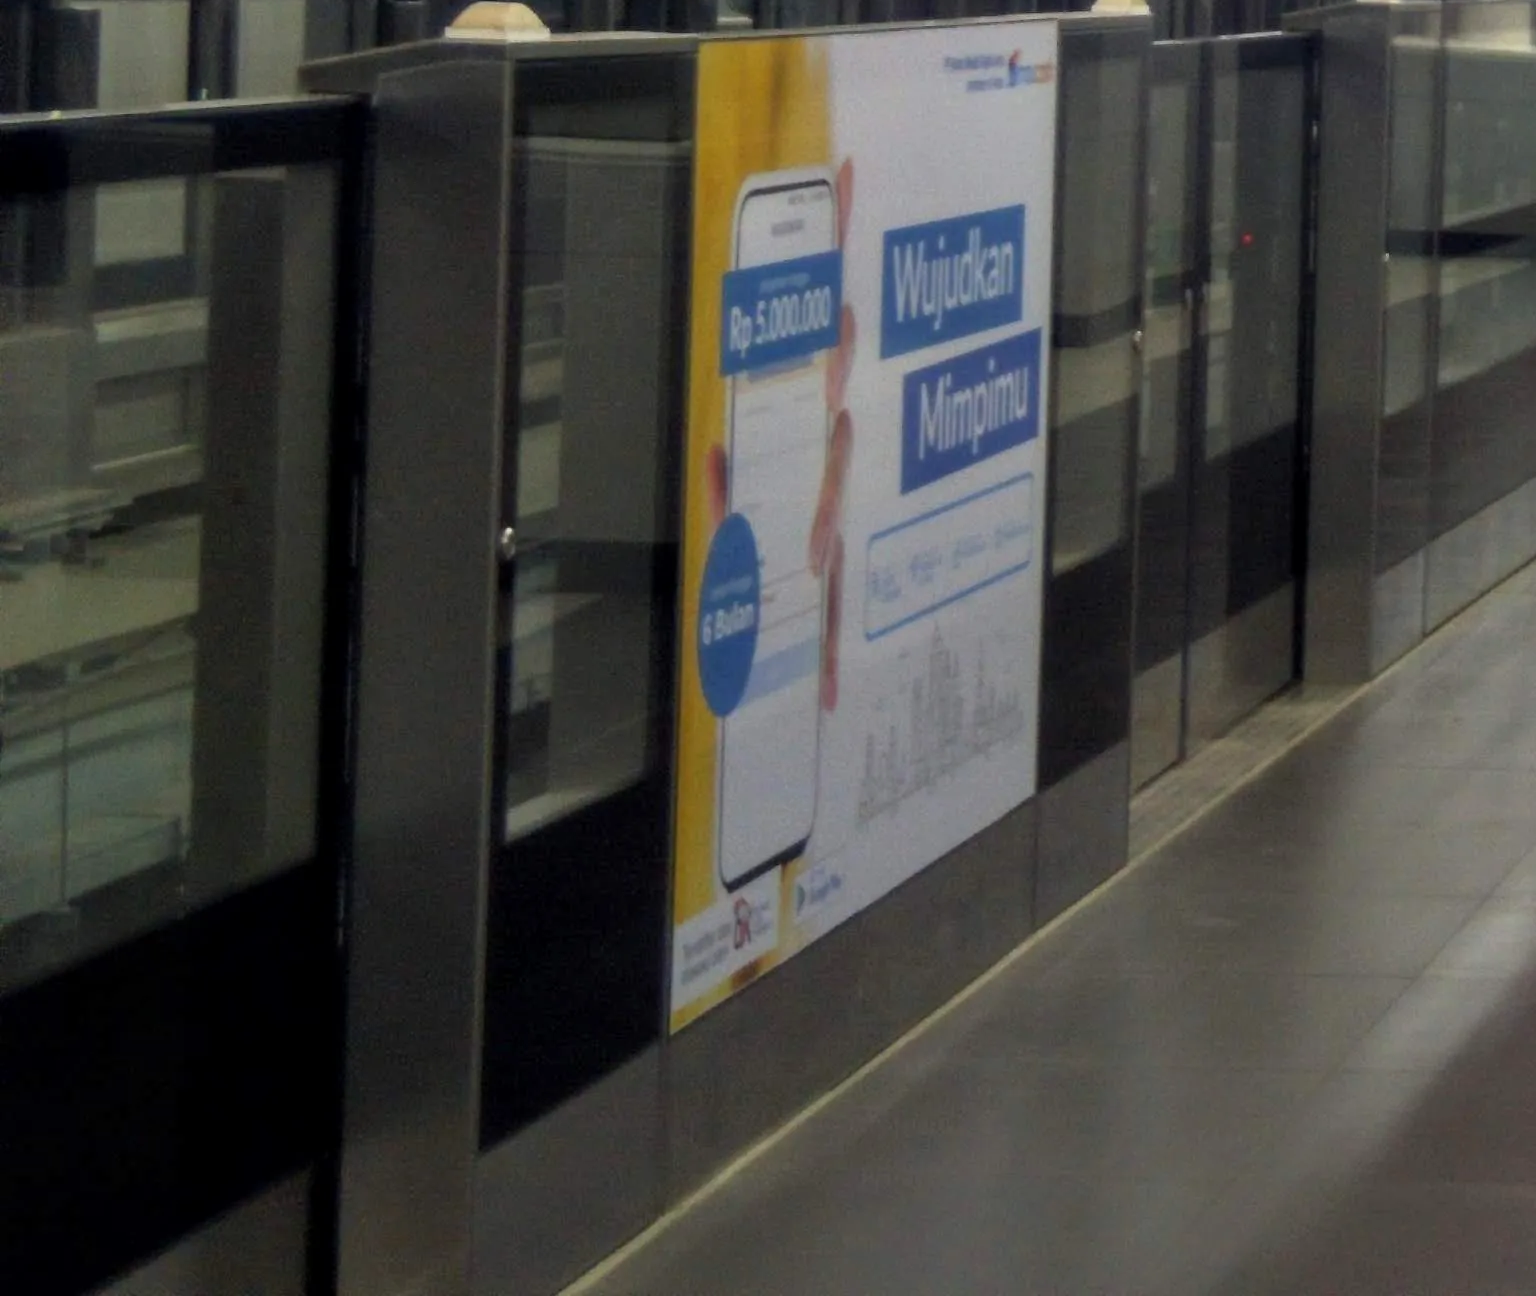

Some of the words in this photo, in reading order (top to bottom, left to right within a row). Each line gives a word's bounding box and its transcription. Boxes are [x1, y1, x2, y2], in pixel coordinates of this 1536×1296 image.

[729, 305, 752, 359] Rp
[755, 285, 832, 345] 5.000.000
[893, 226, 1014, 331] Wujudkan
[918, 356, 1029, 461] Mimpimu
